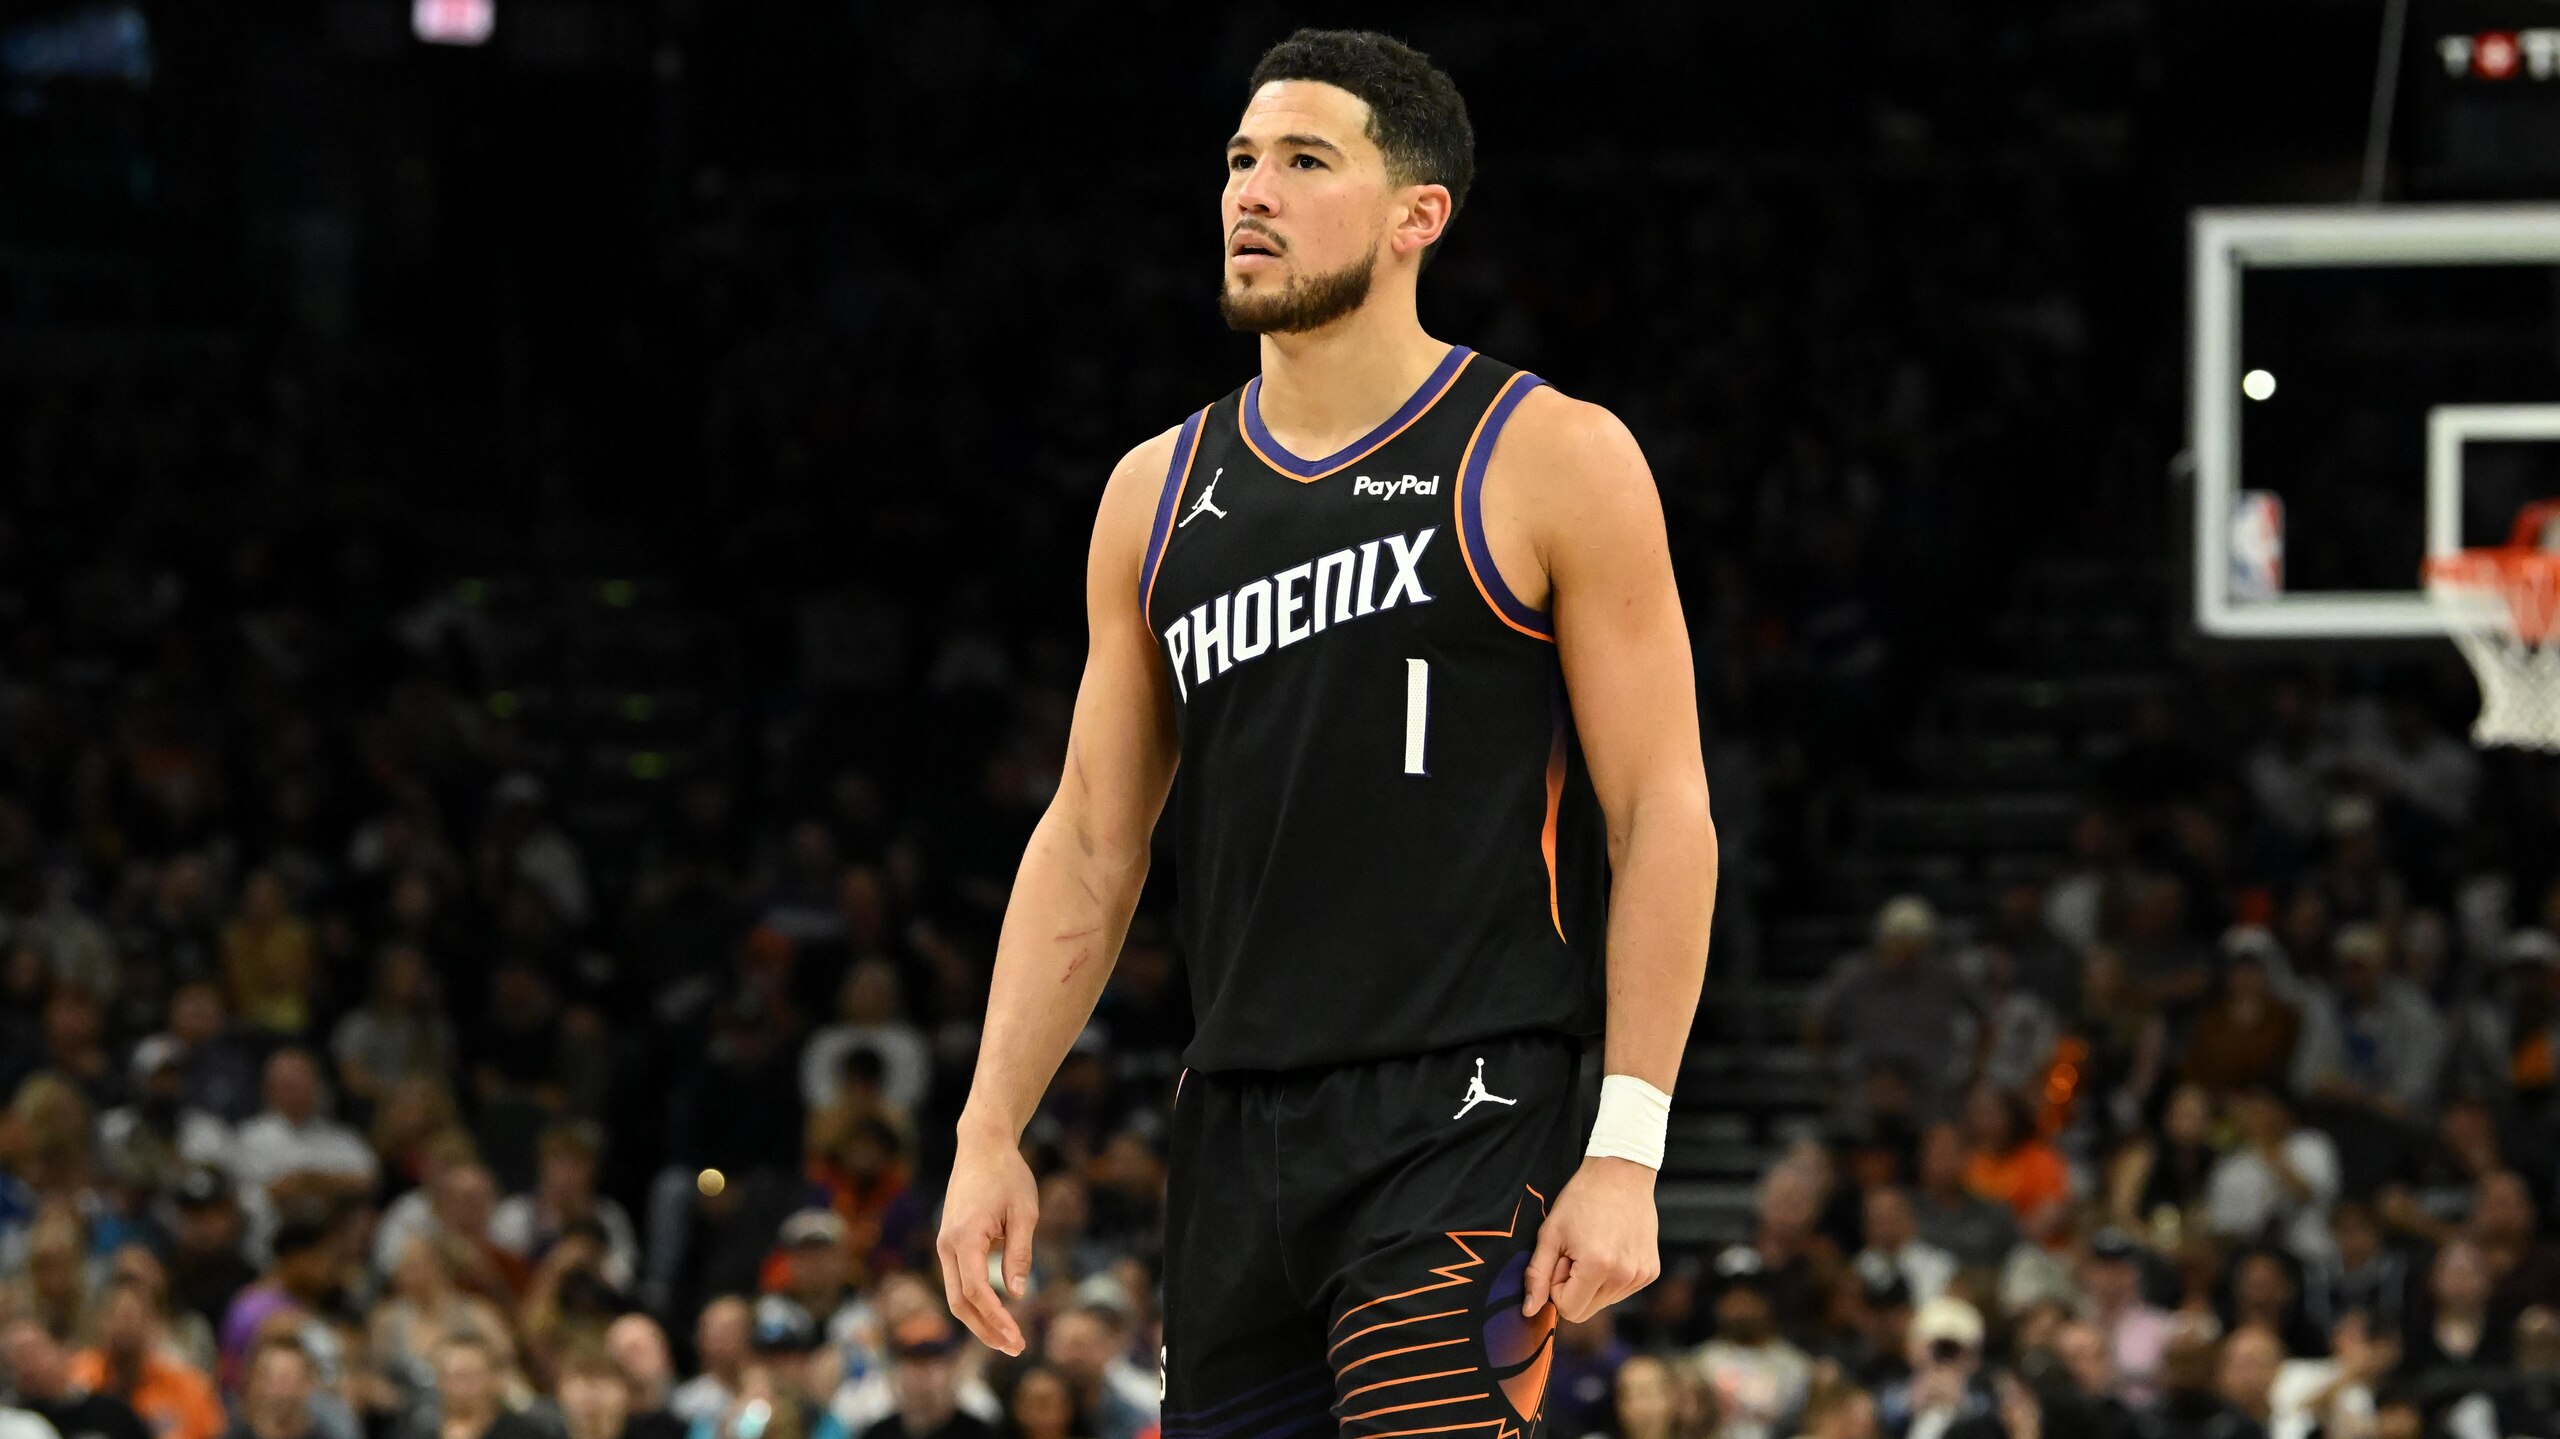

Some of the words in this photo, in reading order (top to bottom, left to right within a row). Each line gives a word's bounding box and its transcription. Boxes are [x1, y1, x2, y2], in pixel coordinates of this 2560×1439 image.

[1353, 474, 1440, 501] PayPal
[1163, 525, 1440, 704] PHOENIX
[1404, 657, 1431, 777] 1
